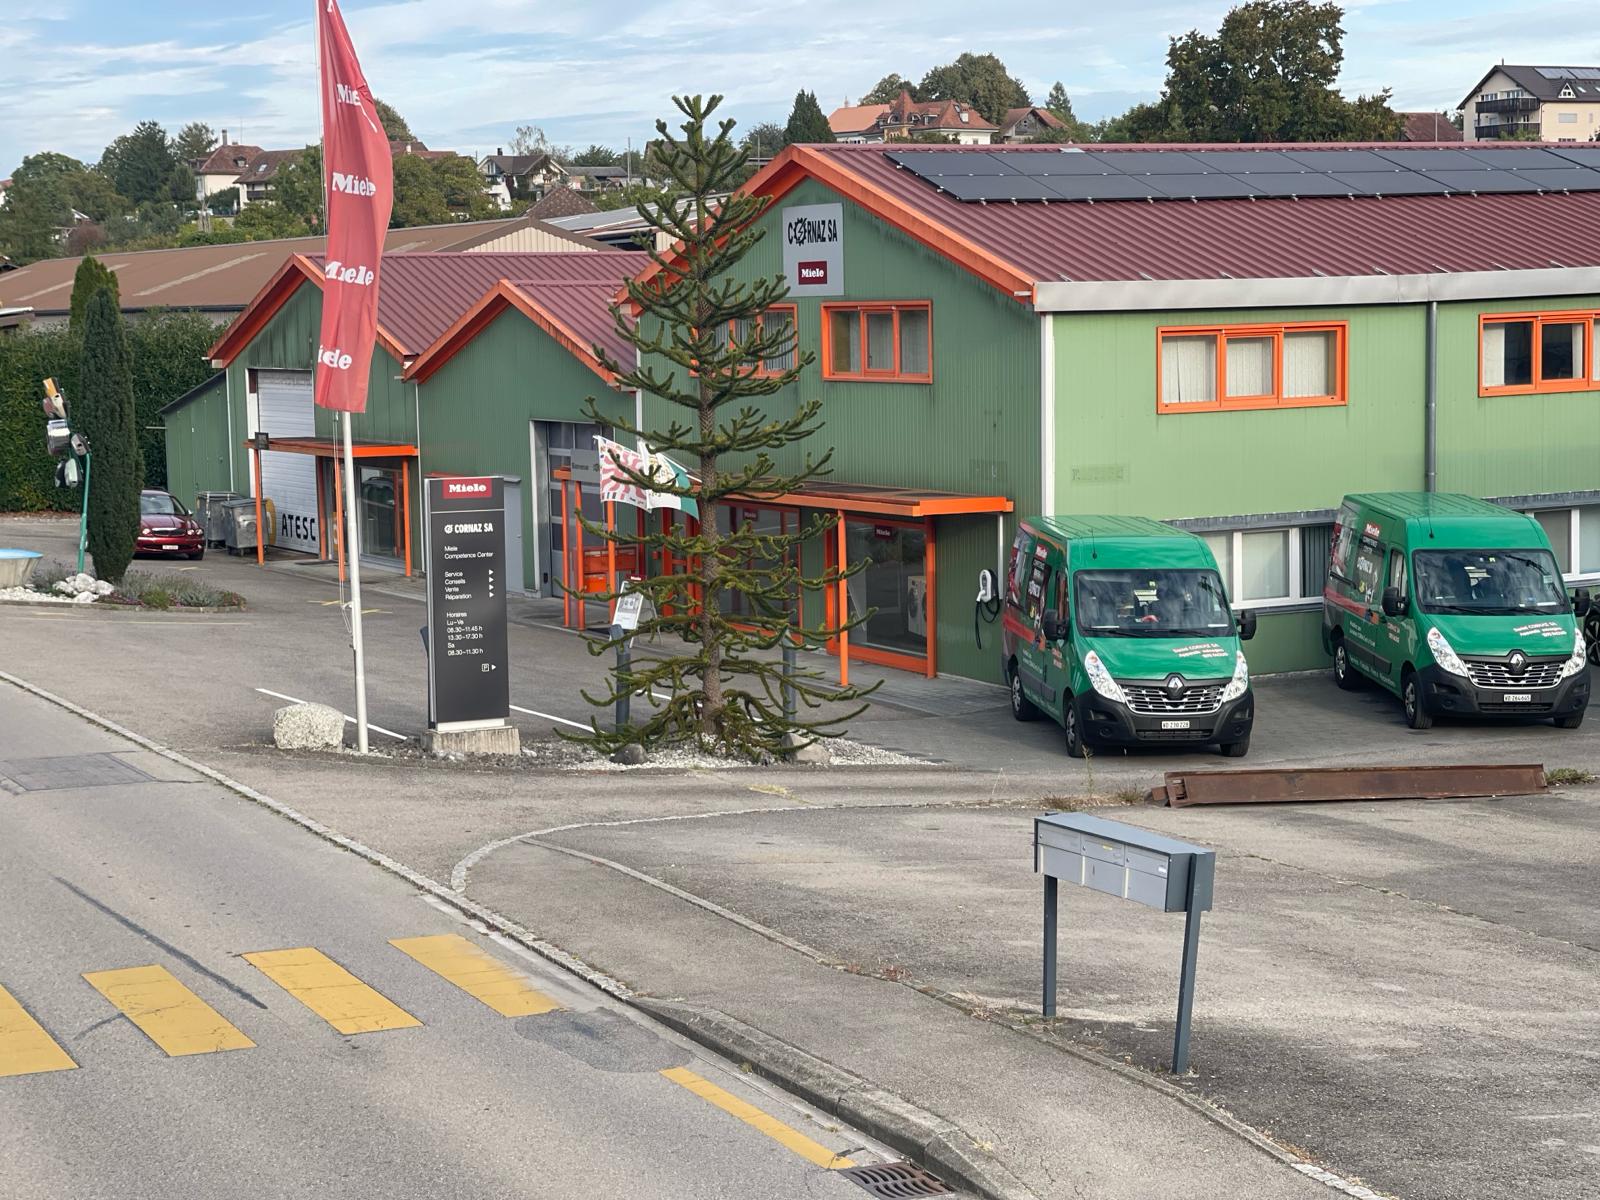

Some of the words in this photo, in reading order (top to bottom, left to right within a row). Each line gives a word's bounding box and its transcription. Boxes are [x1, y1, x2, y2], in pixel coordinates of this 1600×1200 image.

[828, 219, 838, 242] SA
[801, 268, 824, 278] Miele
[449, 483, 486, 493] Miele
[454, 523, 482, 533] CORNAZ
[483, 522, 493, 532] SA
